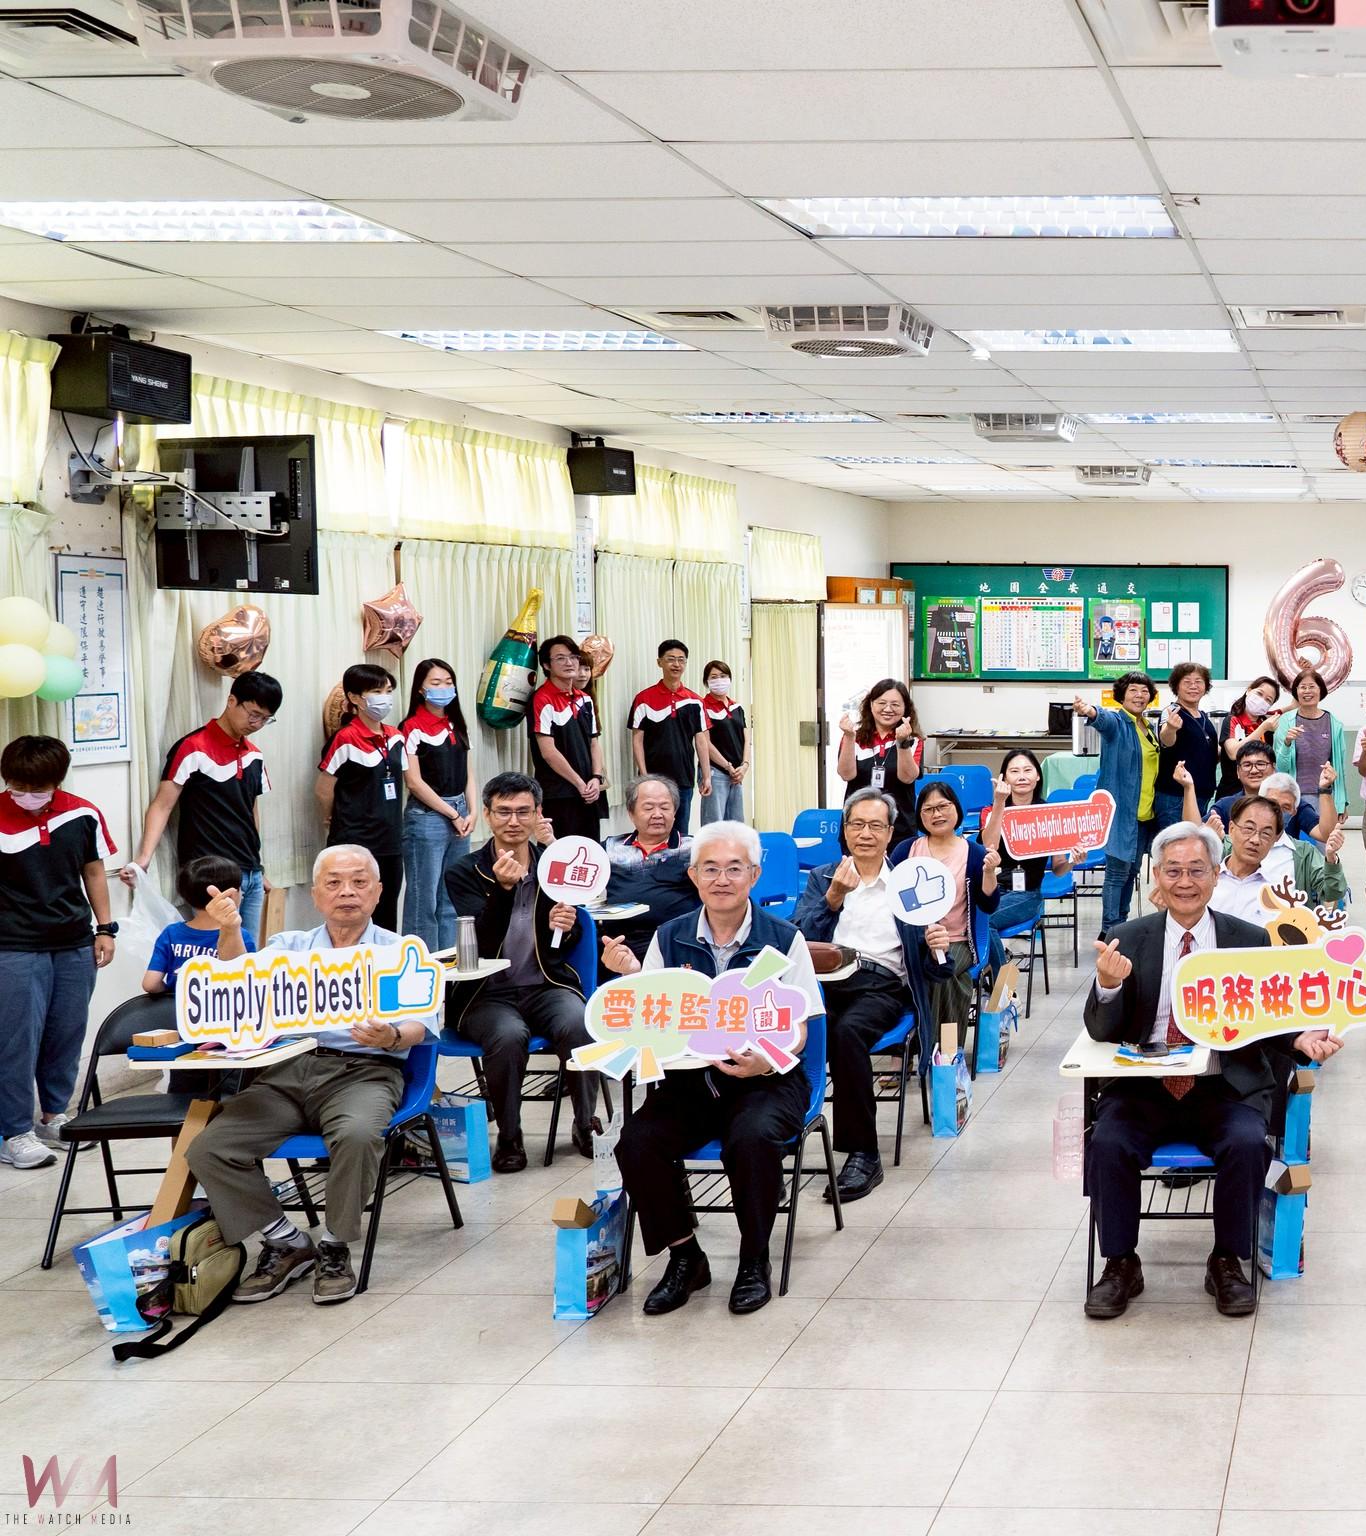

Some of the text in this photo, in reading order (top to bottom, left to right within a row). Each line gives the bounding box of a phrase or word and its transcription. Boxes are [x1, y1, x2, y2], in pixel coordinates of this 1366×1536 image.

[131, 375, 169, 389] YANG SHENG
[819, 820, 839, 835] 56
[1010, 819, 1037, 845] Always
[1036, 813, 1063, 843] helpful
[1062, 811, 1077, 835] and
[187, 973, 267, 1033] Simply
[272, 969, 308, 1017] the
[601, 988, 749, 1033] 雲林監理
